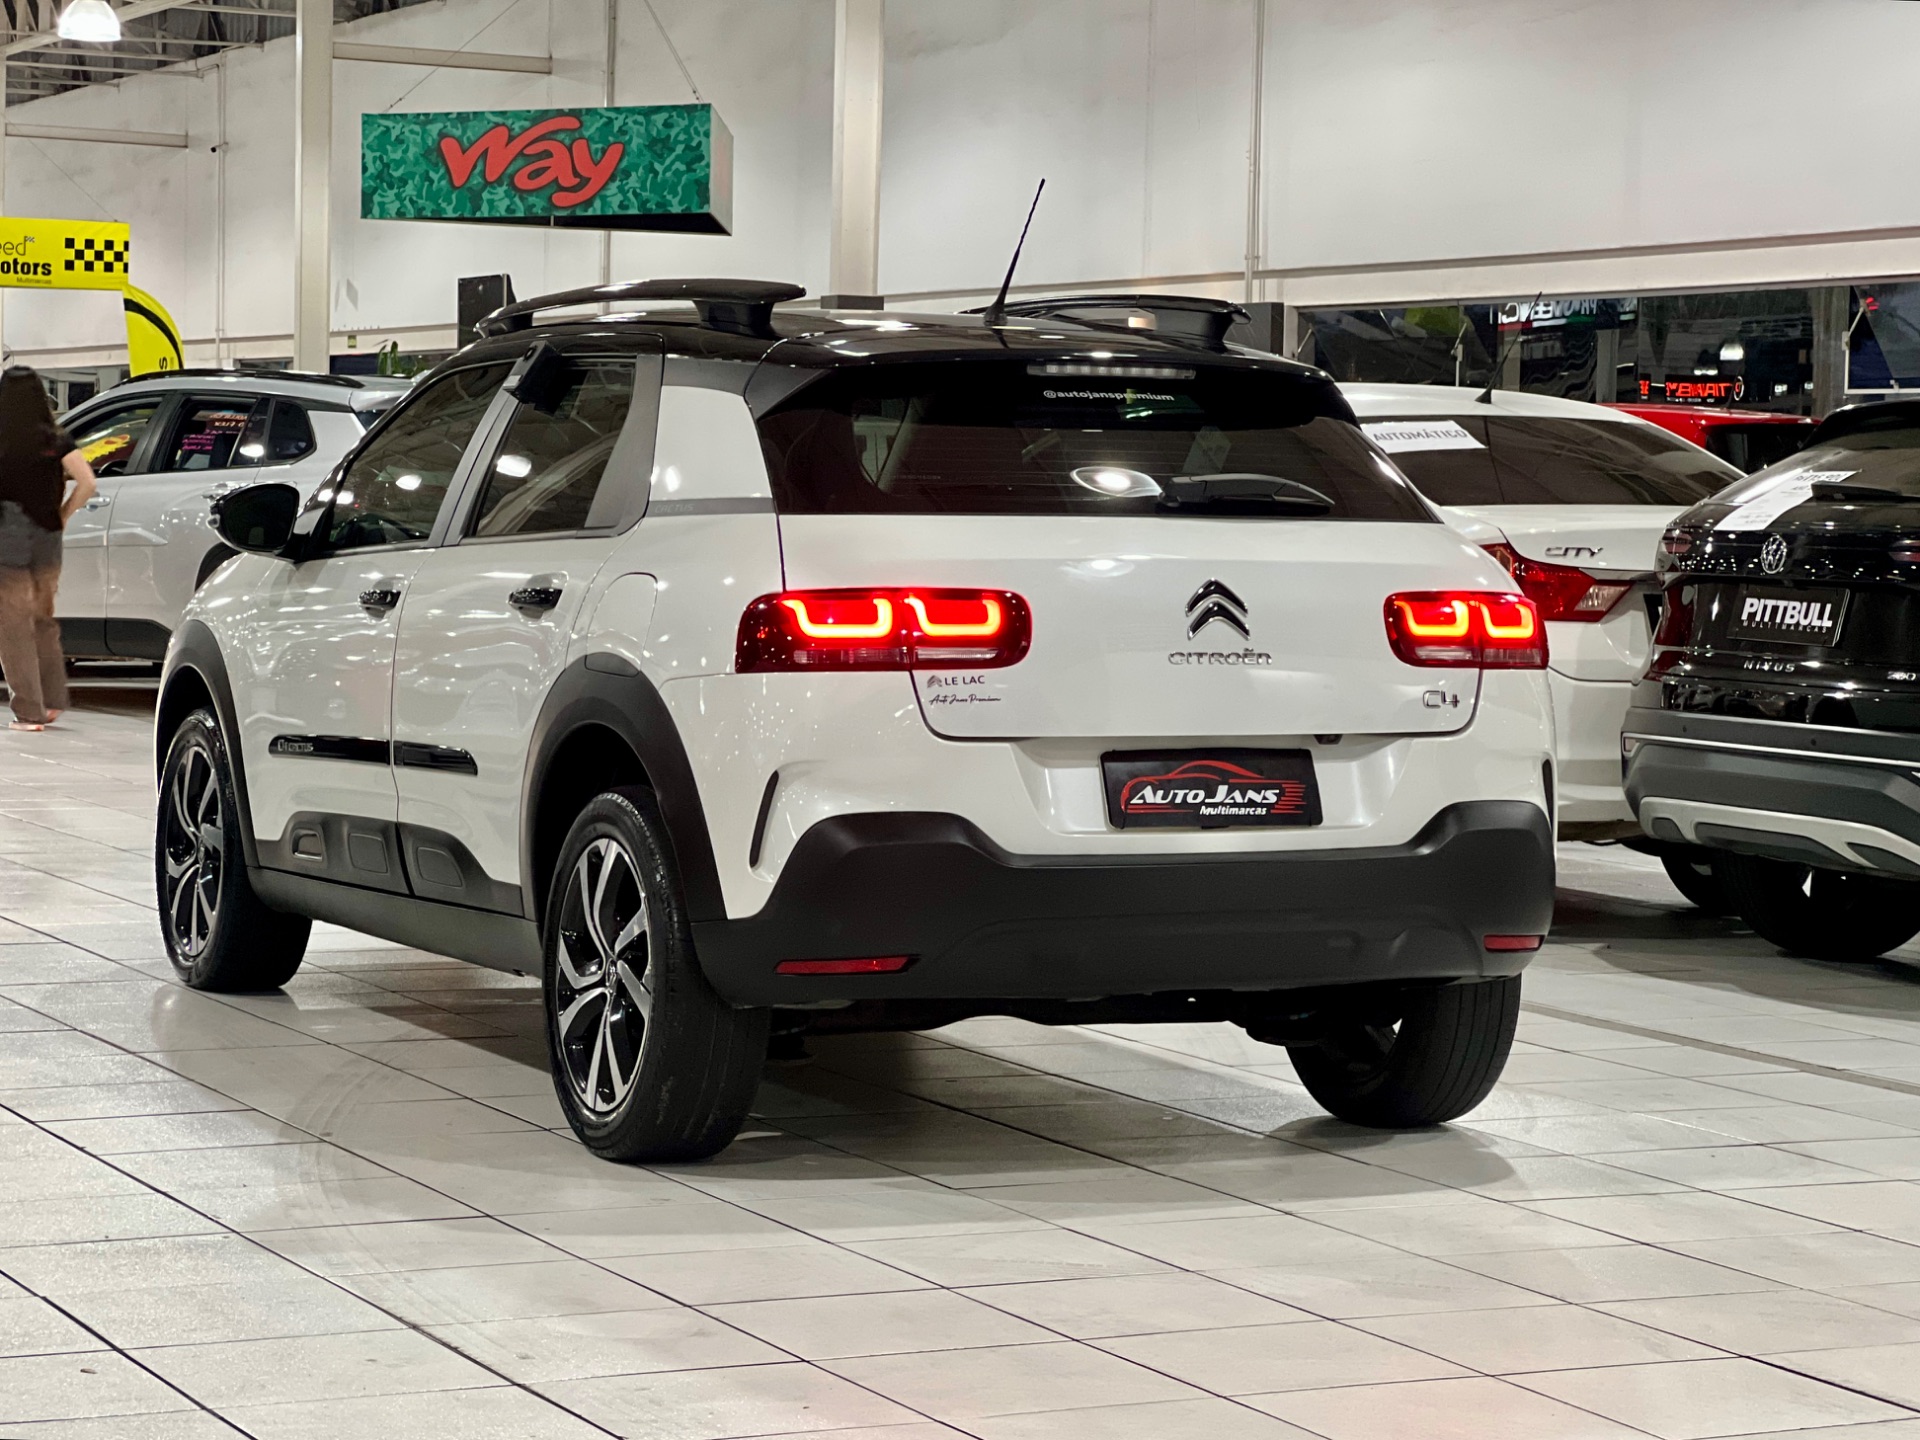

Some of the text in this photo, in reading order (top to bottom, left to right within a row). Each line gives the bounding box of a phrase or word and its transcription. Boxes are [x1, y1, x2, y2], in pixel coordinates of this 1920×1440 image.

[440, 116, 624, 207] Way
[1043, 390, 1175, 401] @autojanspremium
[1373, 429, 1468, 442] AUTOMÁTICO
[1545, 546, 1603, 558] CITY
[1741, 597, 1833, 627] PITTBULL
[1742, 620, 1827, 634] MULTIMARCAS
[944, 675, 986, 686] LE LAC
[1422, 690, 1460, 709] C4
[1200, 805, 1267, 816] Multimarcas
